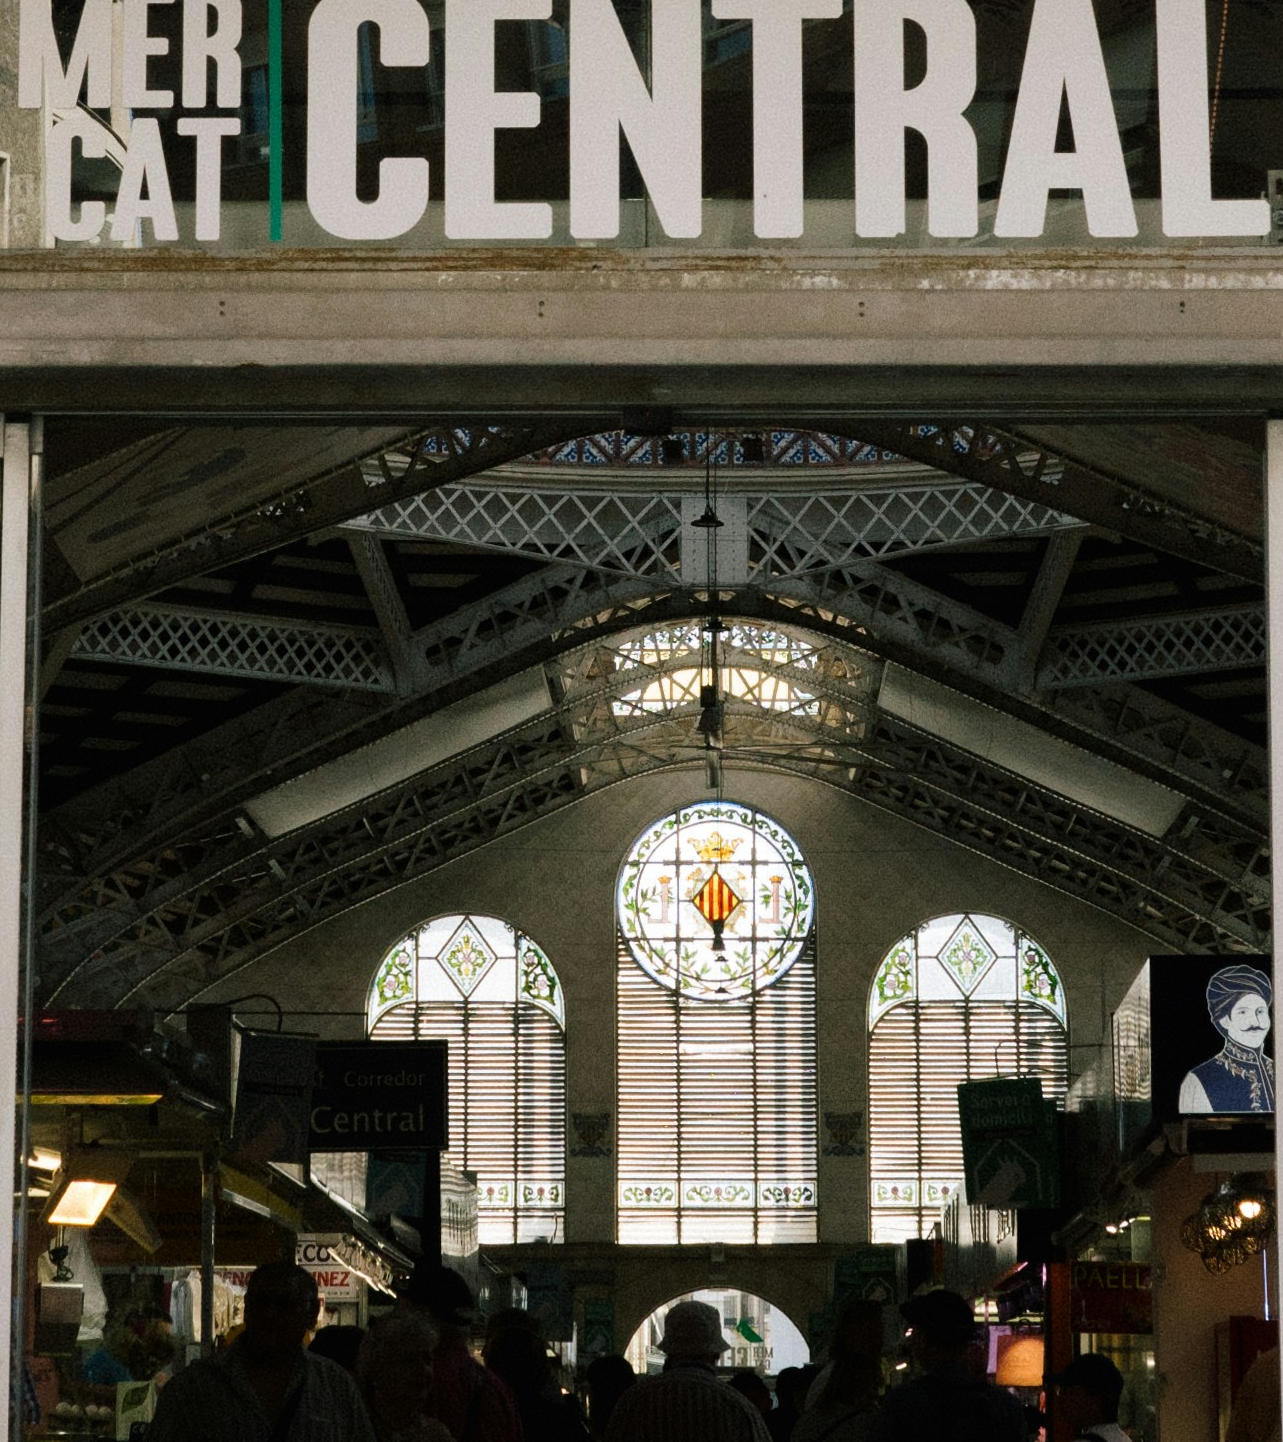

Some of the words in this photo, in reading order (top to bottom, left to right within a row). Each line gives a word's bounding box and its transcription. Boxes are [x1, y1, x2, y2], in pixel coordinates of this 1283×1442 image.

[52, 117, 242, 241] CAT
[343, 1070, 426, 1088] Corredor
[310, 1103, 425, 1135] Central
[1073, 1265, 1153, 1290] PAELL
